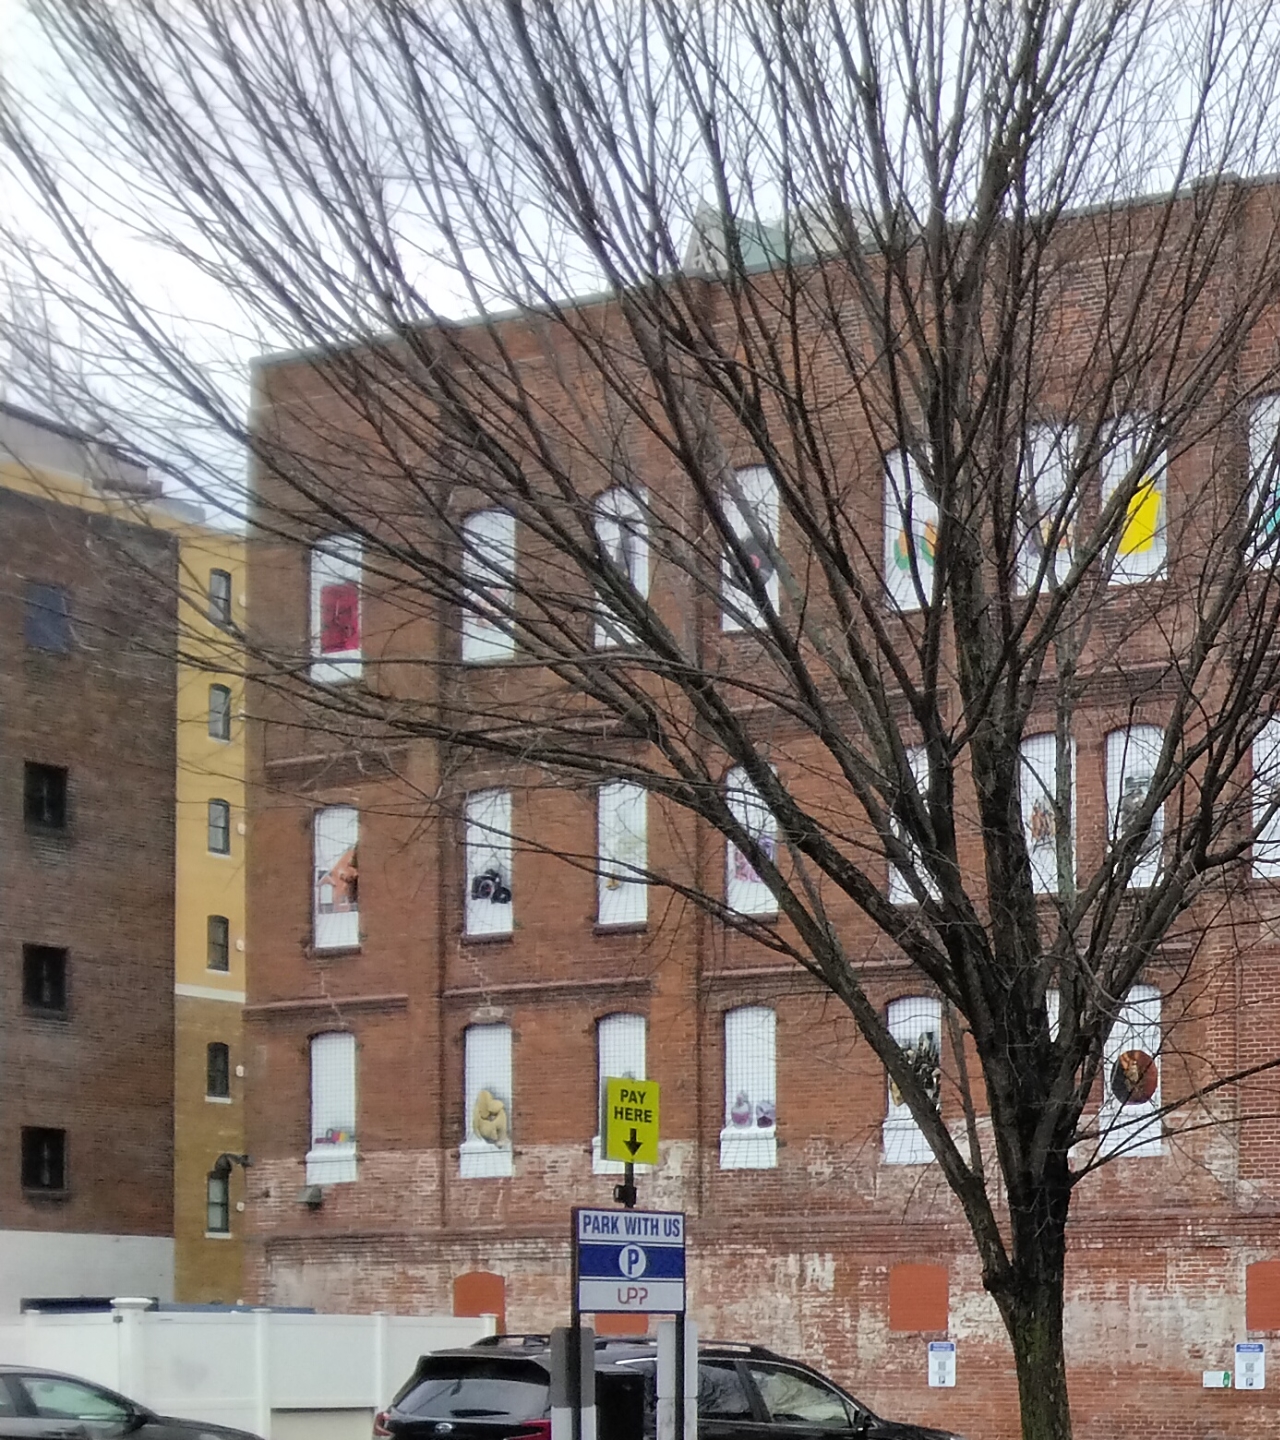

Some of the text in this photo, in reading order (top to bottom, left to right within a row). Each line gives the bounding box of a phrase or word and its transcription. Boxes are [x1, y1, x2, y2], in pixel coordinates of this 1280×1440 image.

[620, 1089, 646, 1104] PAY
[614, 1106, 653, 1123] HERE
[583, 1214, 680, 1237] PARK WITH US
[627, 1249, 640, 1275] P
